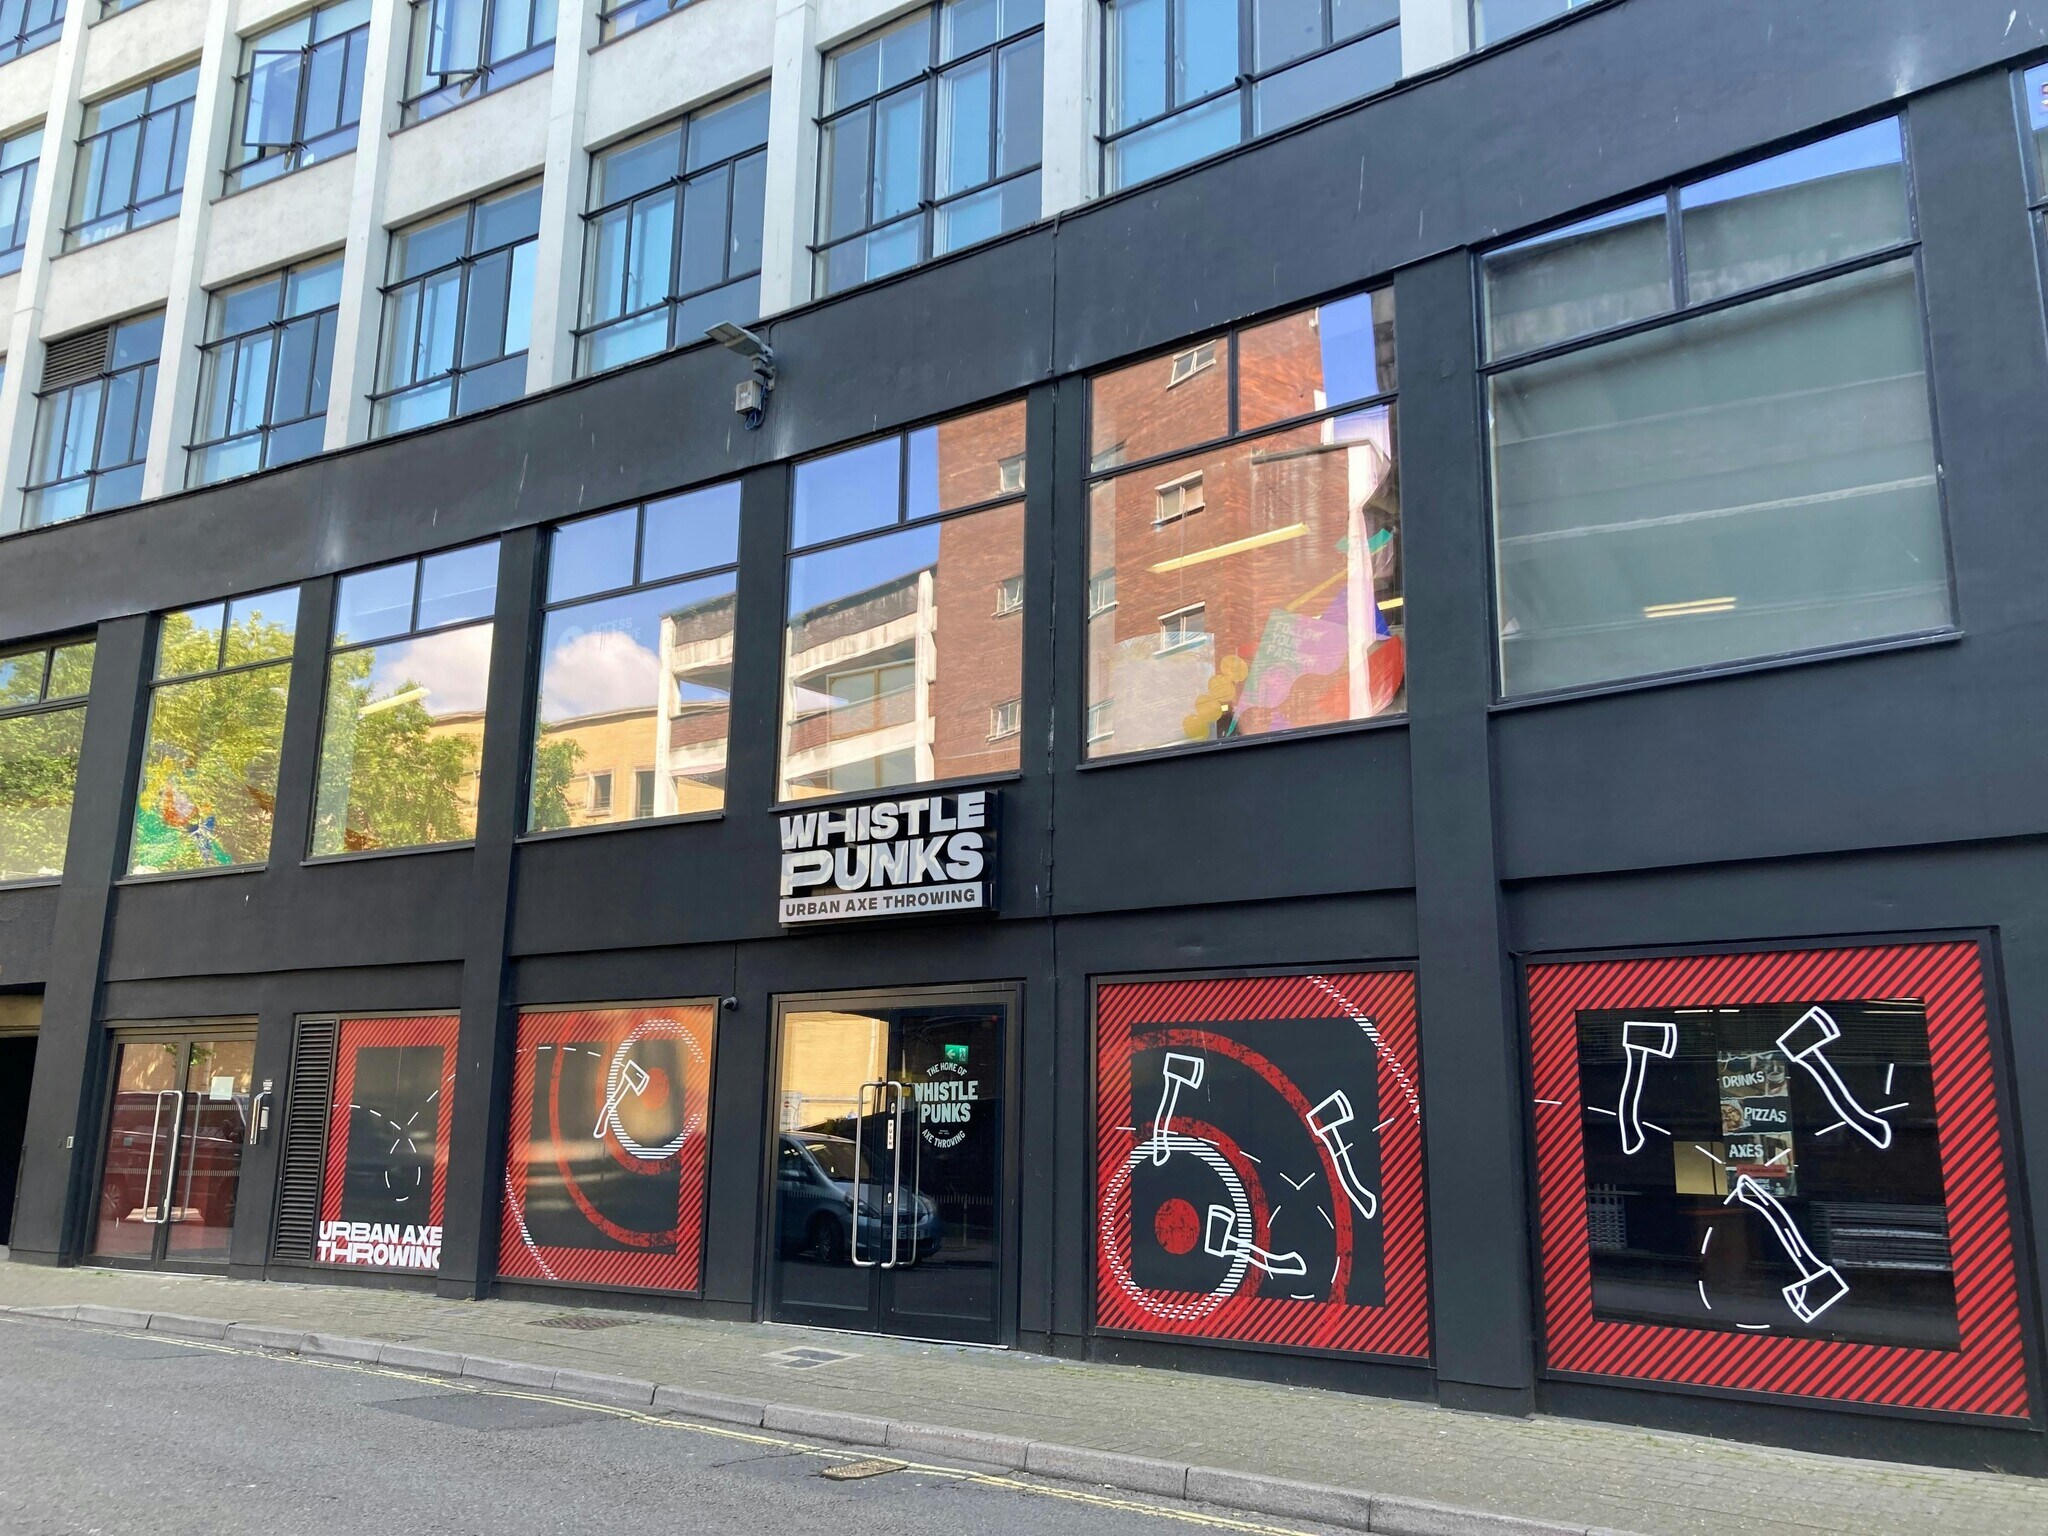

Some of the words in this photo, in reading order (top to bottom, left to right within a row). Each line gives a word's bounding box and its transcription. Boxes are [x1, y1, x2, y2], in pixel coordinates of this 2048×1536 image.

[779, 790, 986, 850] WHISTLE
[780, 832, 984, 896] PUNKS
[785, 900, 840, 917] URBAN
[845, 897, 878, 912] AXE
[883, 888, 975, 909] THROWING
[926, 1063, 940, 1077] THE
[940, 1062, 957, 1072] HOME
[957, 1065, 968, 1076] OF
[1722, 1071, 1765, 1089] DRINKS
[914, 1080, 979, 1102] WHISTLE
[920, 1102, 972, 1124] PUNKS
[1744, 1106, 1787, 1123] PIZZAS
[921, 1128, 935, 1144] AXE
[933, 1130, 966, 1149] THROWING
[1729, 1144, 1764, 1158] AXES
[319, 1220, 400, 1244] URBAN
[402, 1225, 443, 1246] AXE
